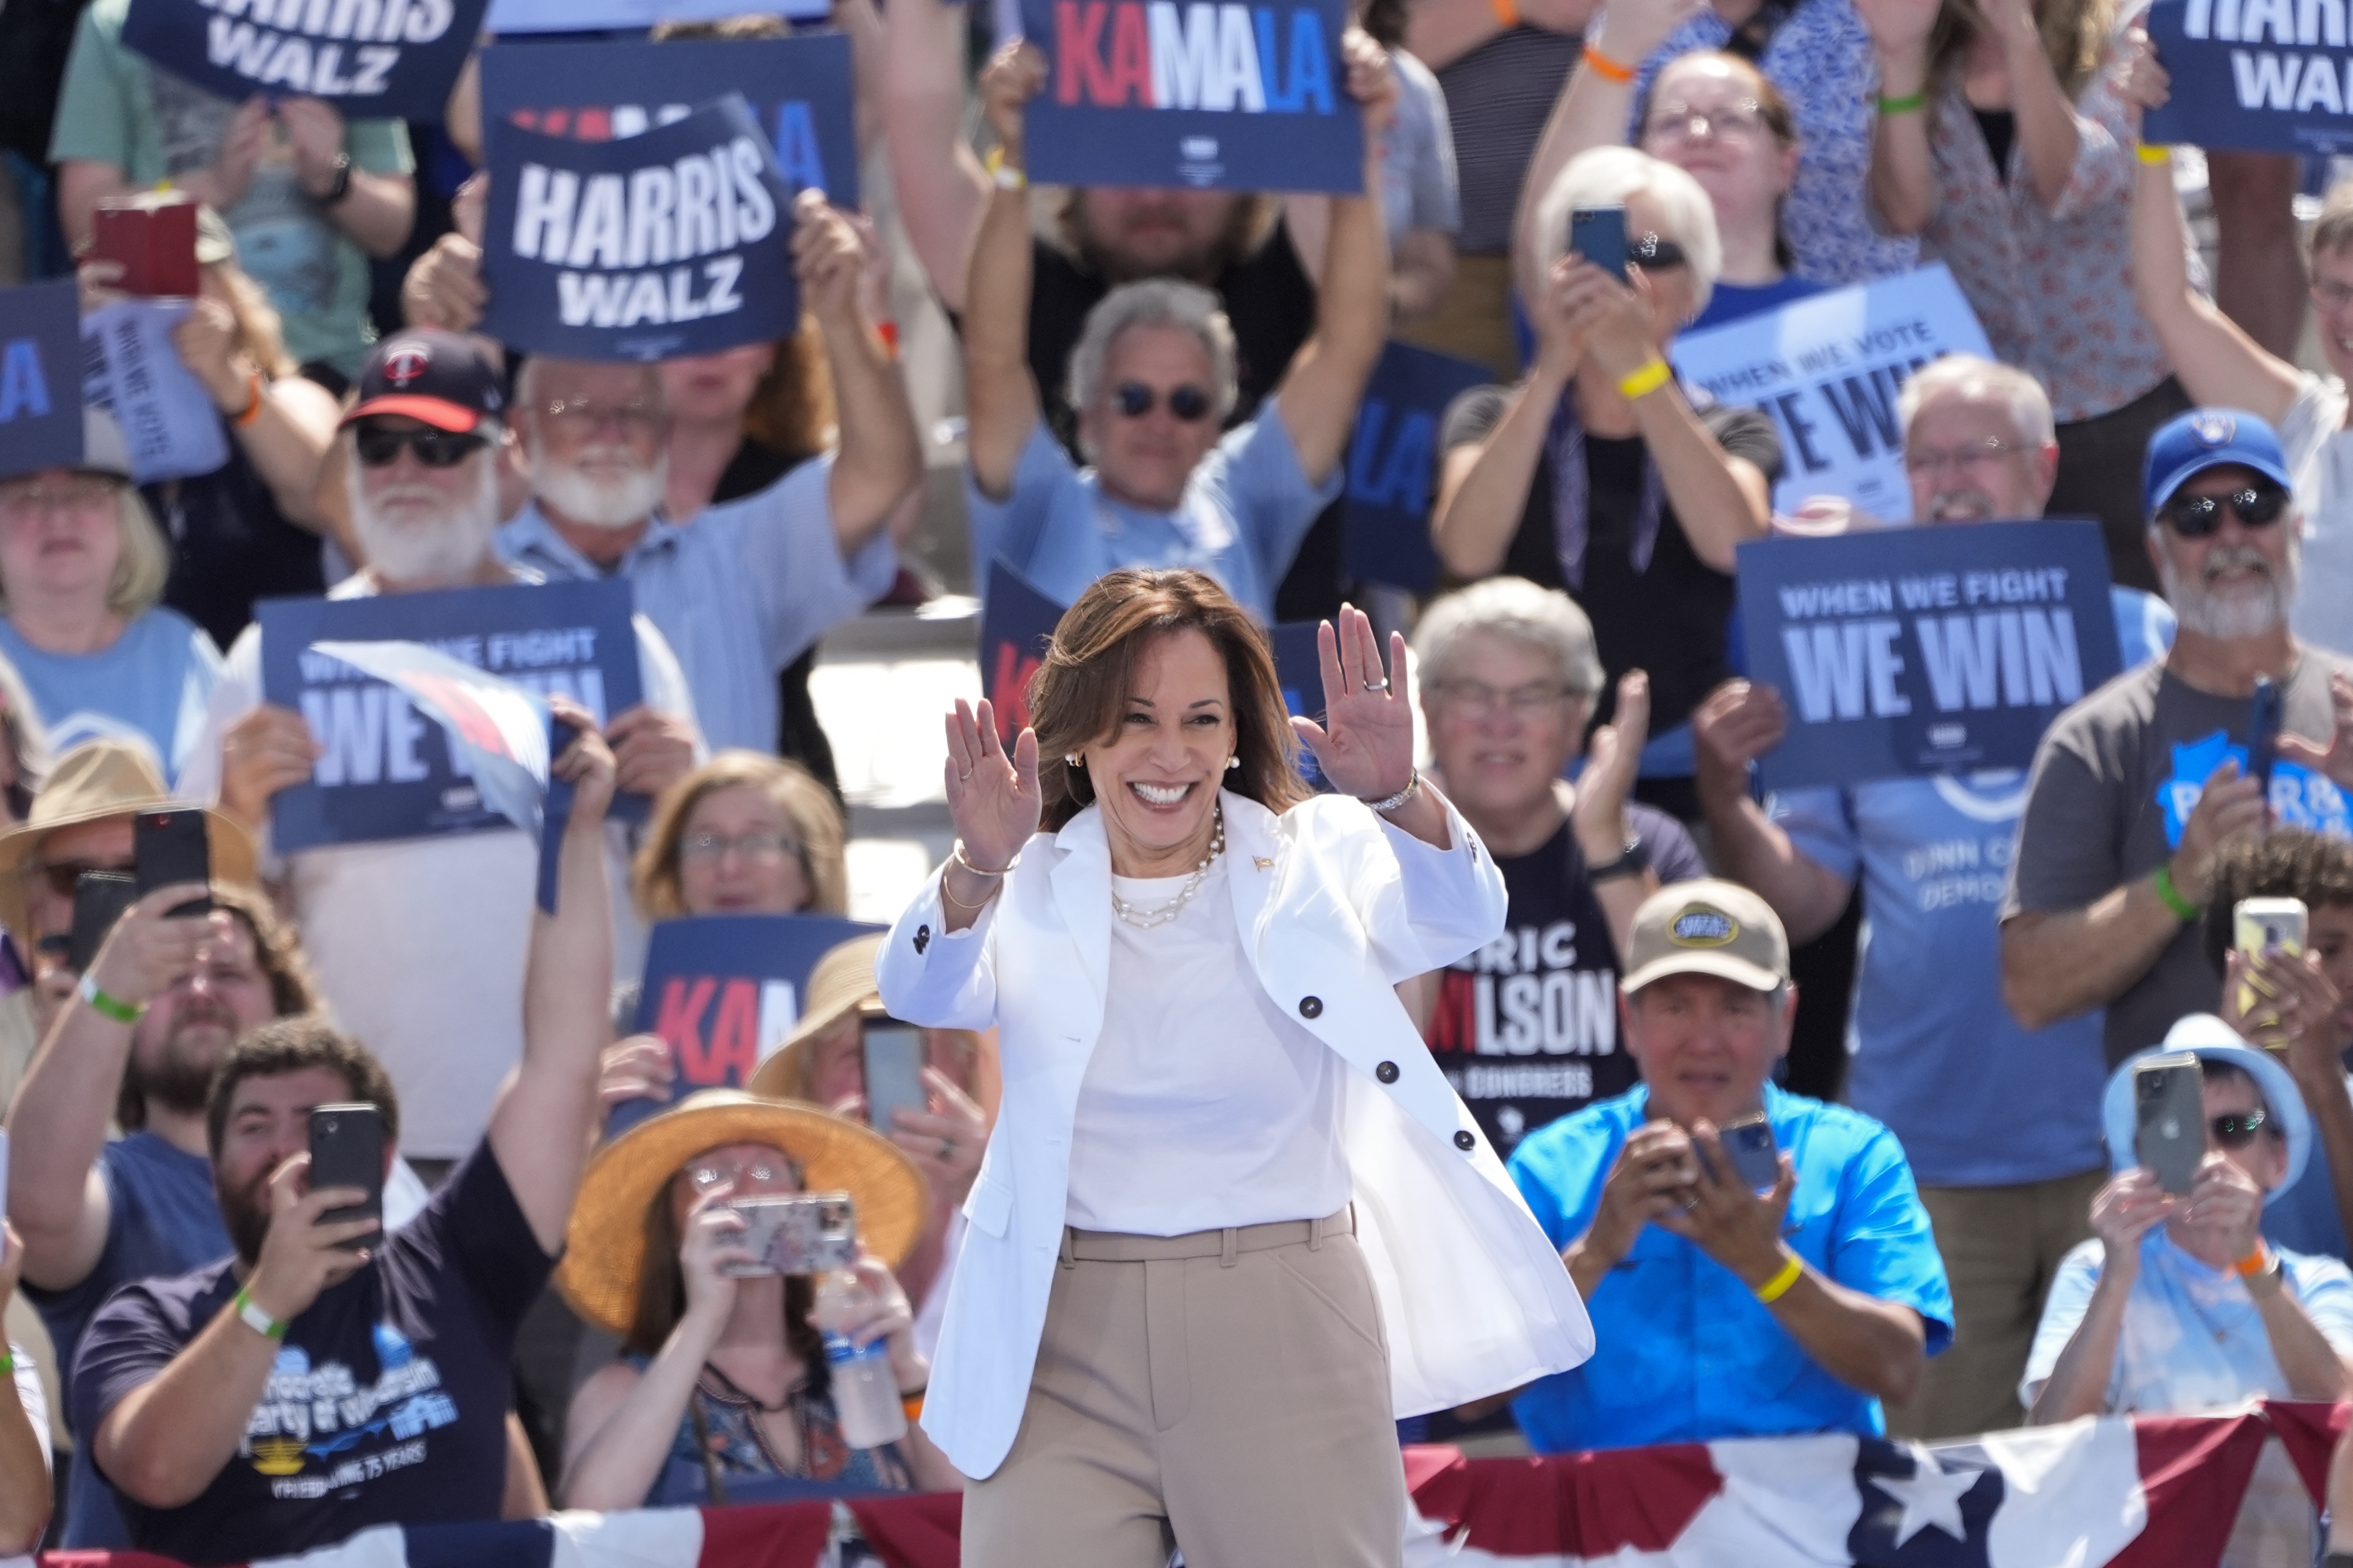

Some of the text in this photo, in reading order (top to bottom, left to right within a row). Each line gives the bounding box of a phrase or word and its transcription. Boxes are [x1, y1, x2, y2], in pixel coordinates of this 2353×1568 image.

[206, 15, 401, 96] WALZ
[1055, 0, 1337, 114] KAMALA
[2230, 48, 2353, 115] WA
[513, 136, 775, 269] HARRIS
[558, 255, 743, 328] WALZ
[1703, 359, 1793, 396] WHEN
[1852, 320, 1935, 354] VOTE
[1778, 566, 2069, 620] WHEN WE FIGHT
[1782, 603, 2086, 726] WE WIN
[301, 683, 430, 787] WE
[1452, 920, 1578, 976] RIC
